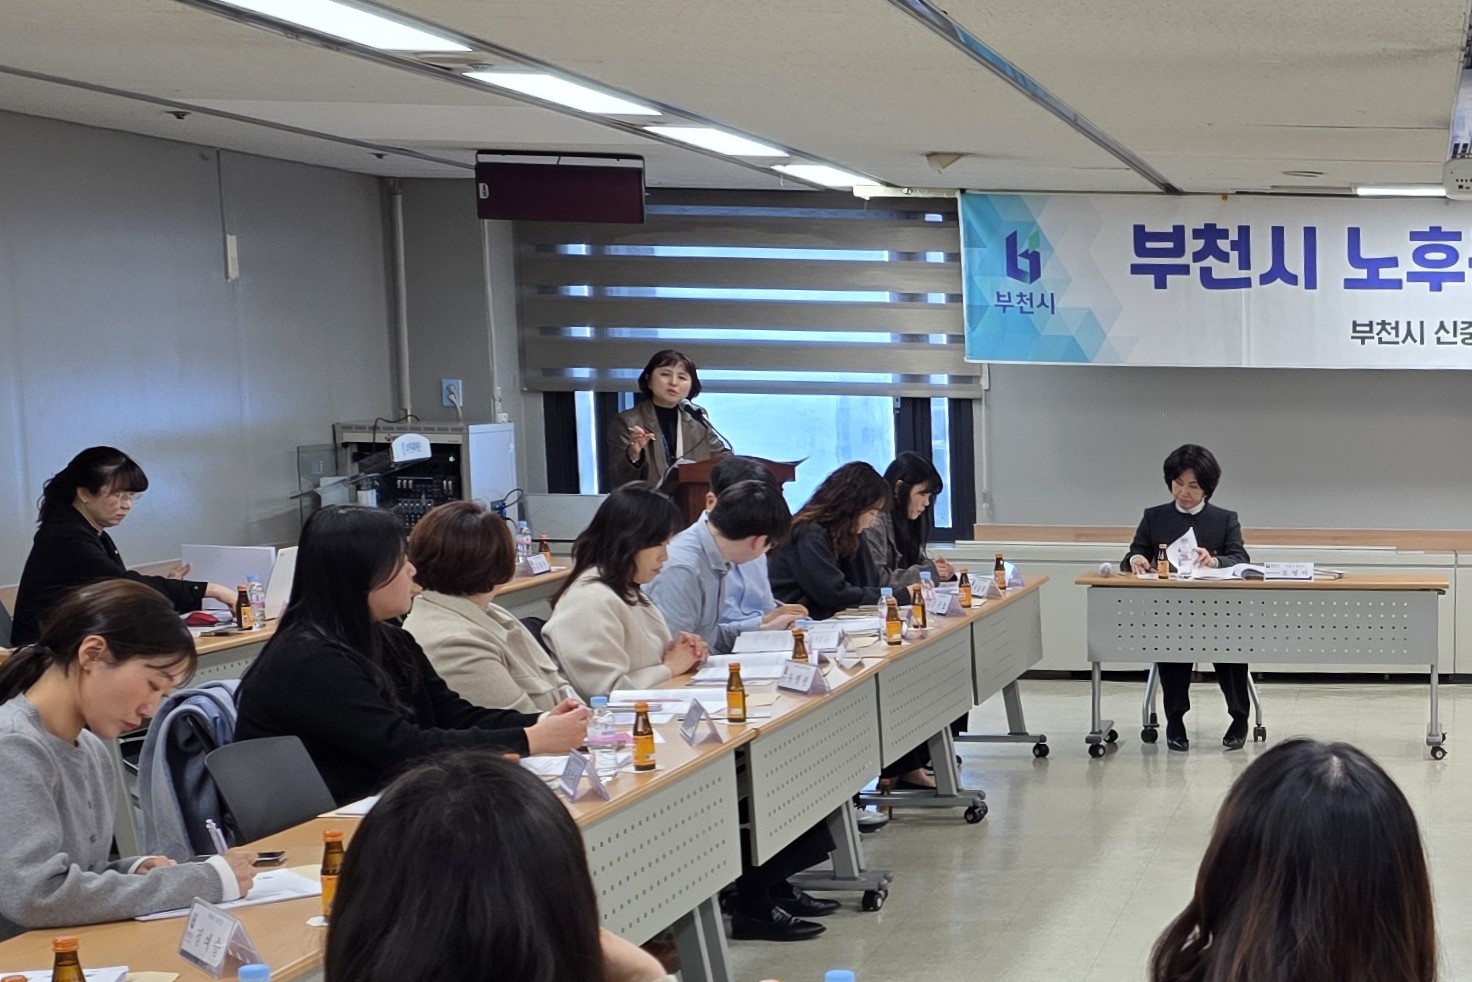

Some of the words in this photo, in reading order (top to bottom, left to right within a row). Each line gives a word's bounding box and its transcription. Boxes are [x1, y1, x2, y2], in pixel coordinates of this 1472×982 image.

[1130, 223, 1317, 290] 부천시
[994, 290, 1055, 315] 부천시
[1350, 319, 1425, 347] 부천시
